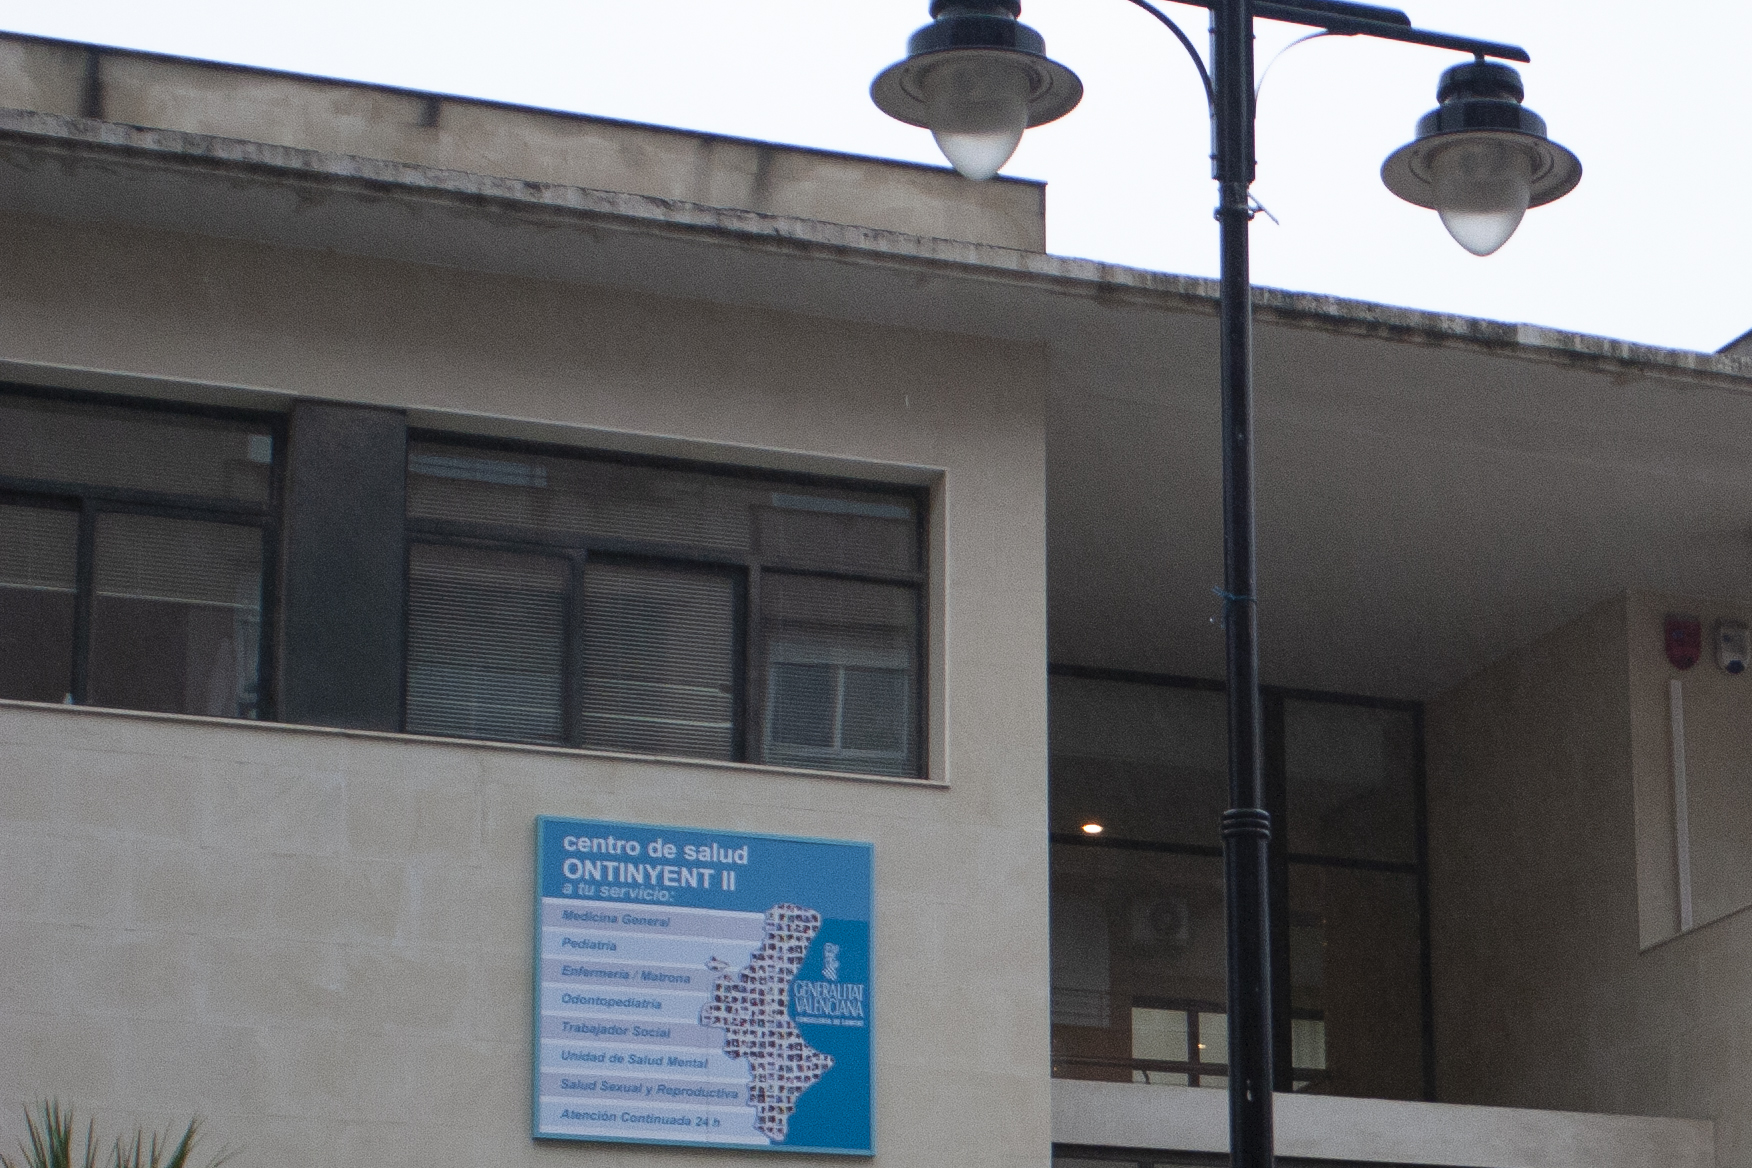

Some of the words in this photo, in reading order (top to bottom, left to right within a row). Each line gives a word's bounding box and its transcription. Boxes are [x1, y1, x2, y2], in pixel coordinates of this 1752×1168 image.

[563, 835, 640, 856] centro
[648, 838, 676, 858] de
[684, 843, 748, 865] salud
[563, 858, 714, 889] ONTINYENT
[721, 870, 736, 891] II
[562, 883, 573, 894] a
[577, 882, 595, 896] tu
[599, 886, 675, 901] servicio:
[562, 909, 618, 924] Medicina
[622, 913, 671, 927] General
[640, 970, 690, 984] Matrona
[794, 981, 864, 1001] GENERALITAT
[796, 997, 864, 1018] VALENCIANA
[562, 1021, 629, 1036] Trabajador
[632, 1025, 671, 1038] Social
[561, 1049, 606, 1063] Unidad
[609, 1053, 624, 1064] de
[628, 1053, 663, 1066] Salud
[667, 1056, 708, 1069] Mental
[560, 1078, 597, 1091] Salud
[601, 1080, 642, 1094] Sexual
[645, 1086, 652, 1096] y
[656, 1084, 739, 1099] Reproductiva
[620, 1112, 692, 1126] Continuada
[695, 1116, 709, 1127] 24
